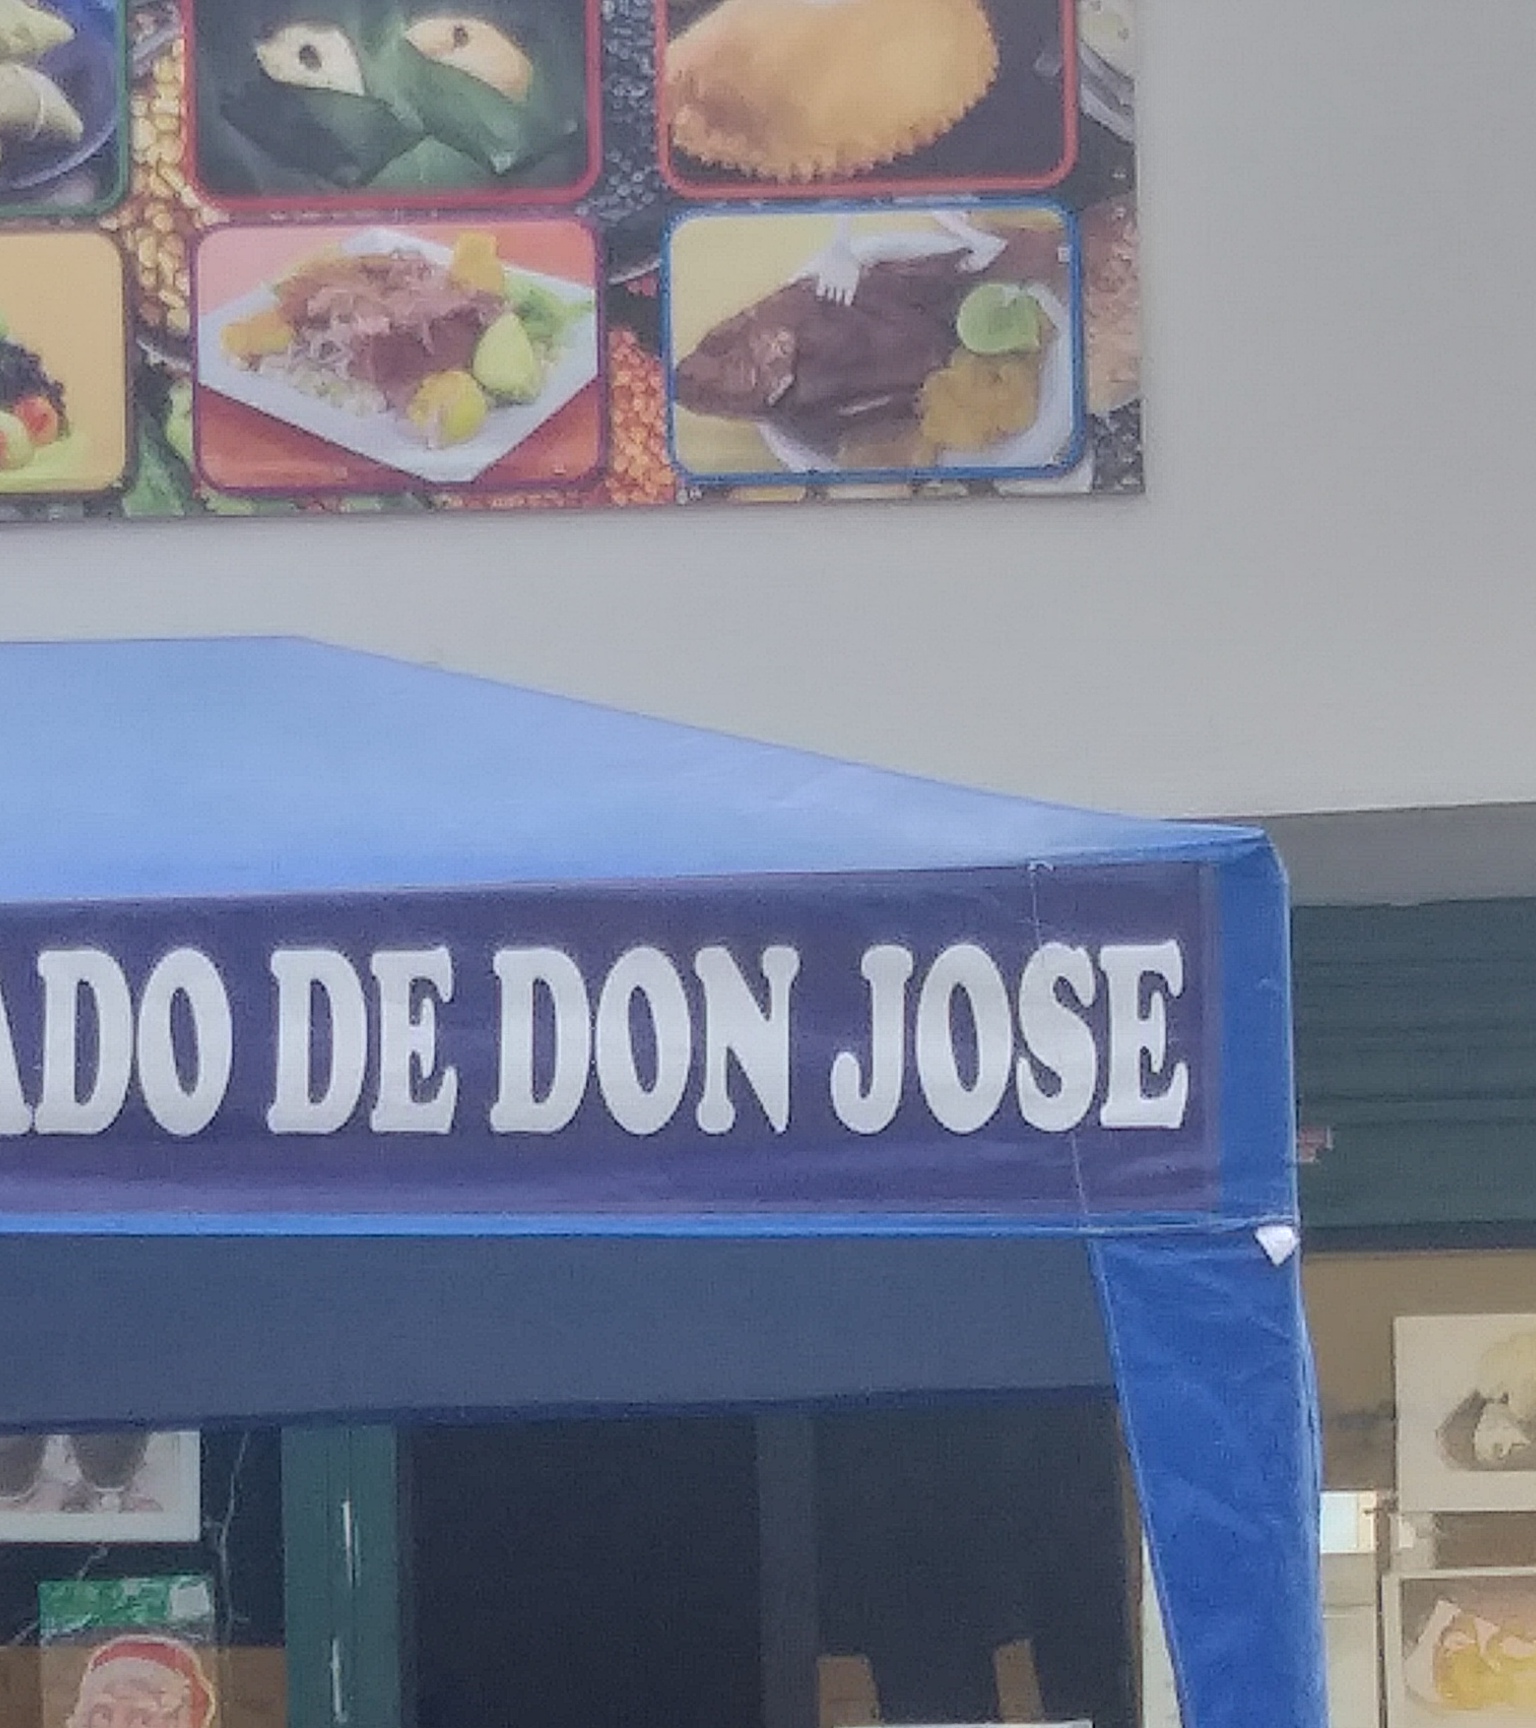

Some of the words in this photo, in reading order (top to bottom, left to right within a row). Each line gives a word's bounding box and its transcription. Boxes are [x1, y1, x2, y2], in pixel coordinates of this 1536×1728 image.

[266, 945, 458, 1134] DE
[489, 945, 800, 1134] DON
[830, 938, 1189, 1134] JOSE
